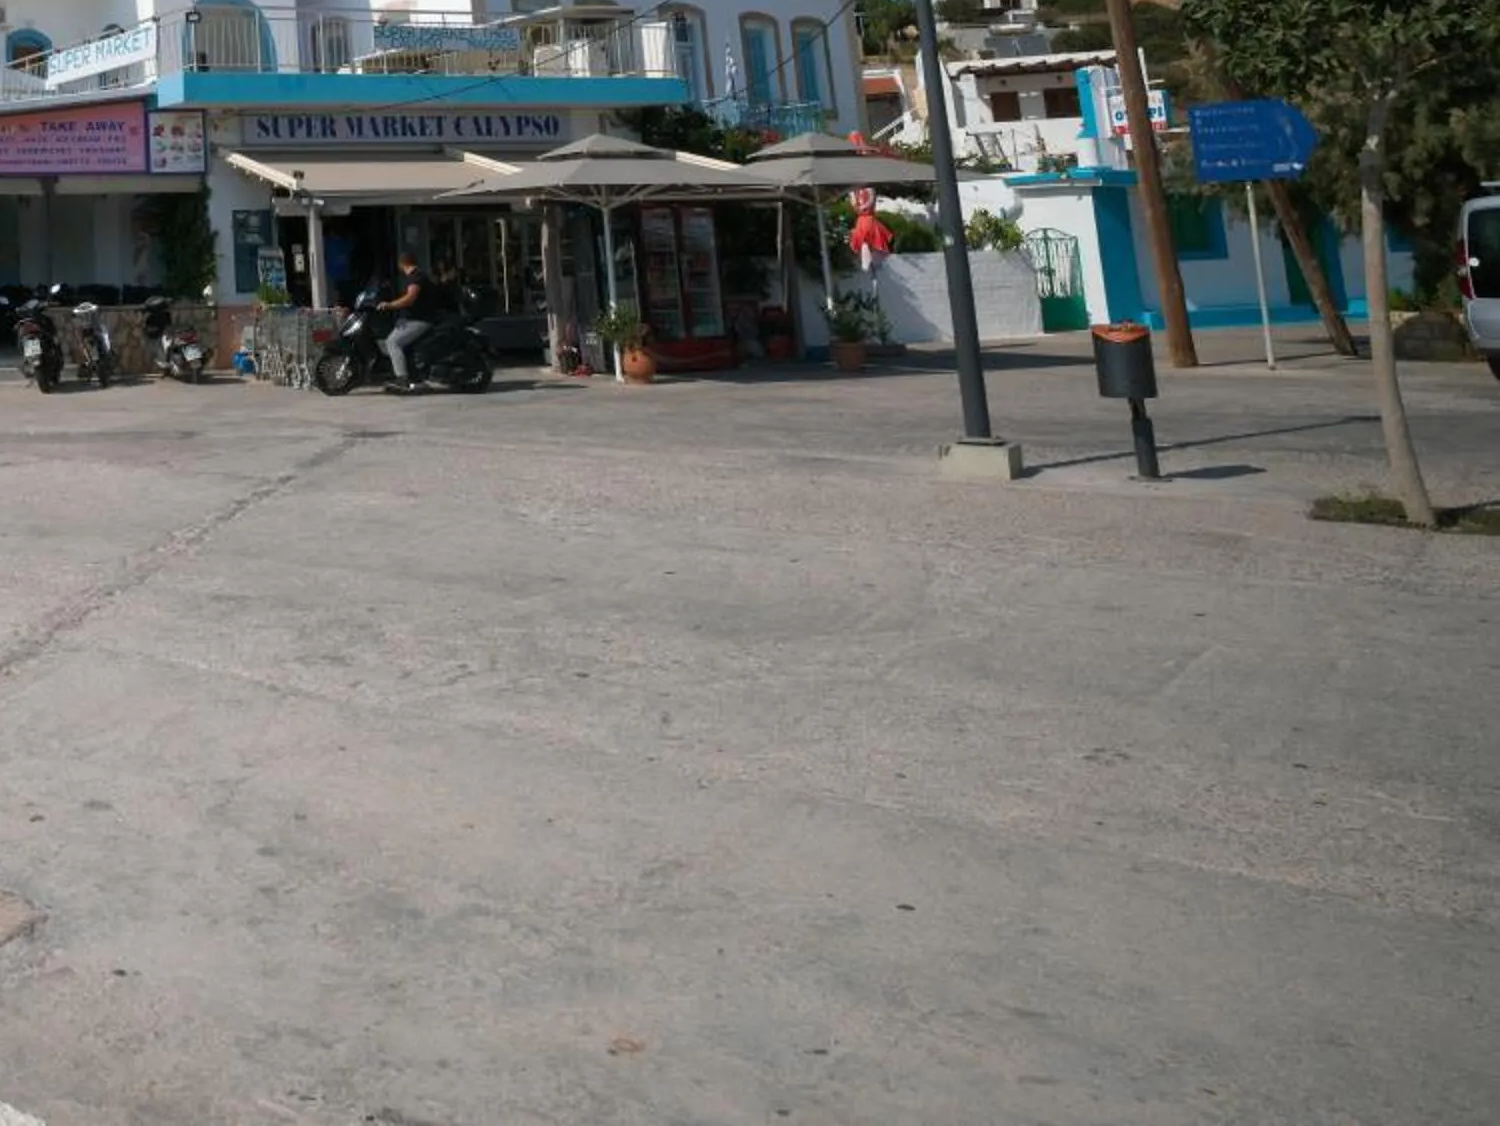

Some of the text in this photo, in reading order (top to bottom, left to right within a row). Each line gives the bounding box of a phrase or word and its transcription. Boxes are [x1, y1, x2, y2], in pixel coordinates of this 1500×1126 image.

[49, 27, 152, 74] SUPER MARKET
[39, 120, 126, 131] TAKE AWAY
[257, 114, 560, 138] SUPER MARKET CALYPSO
